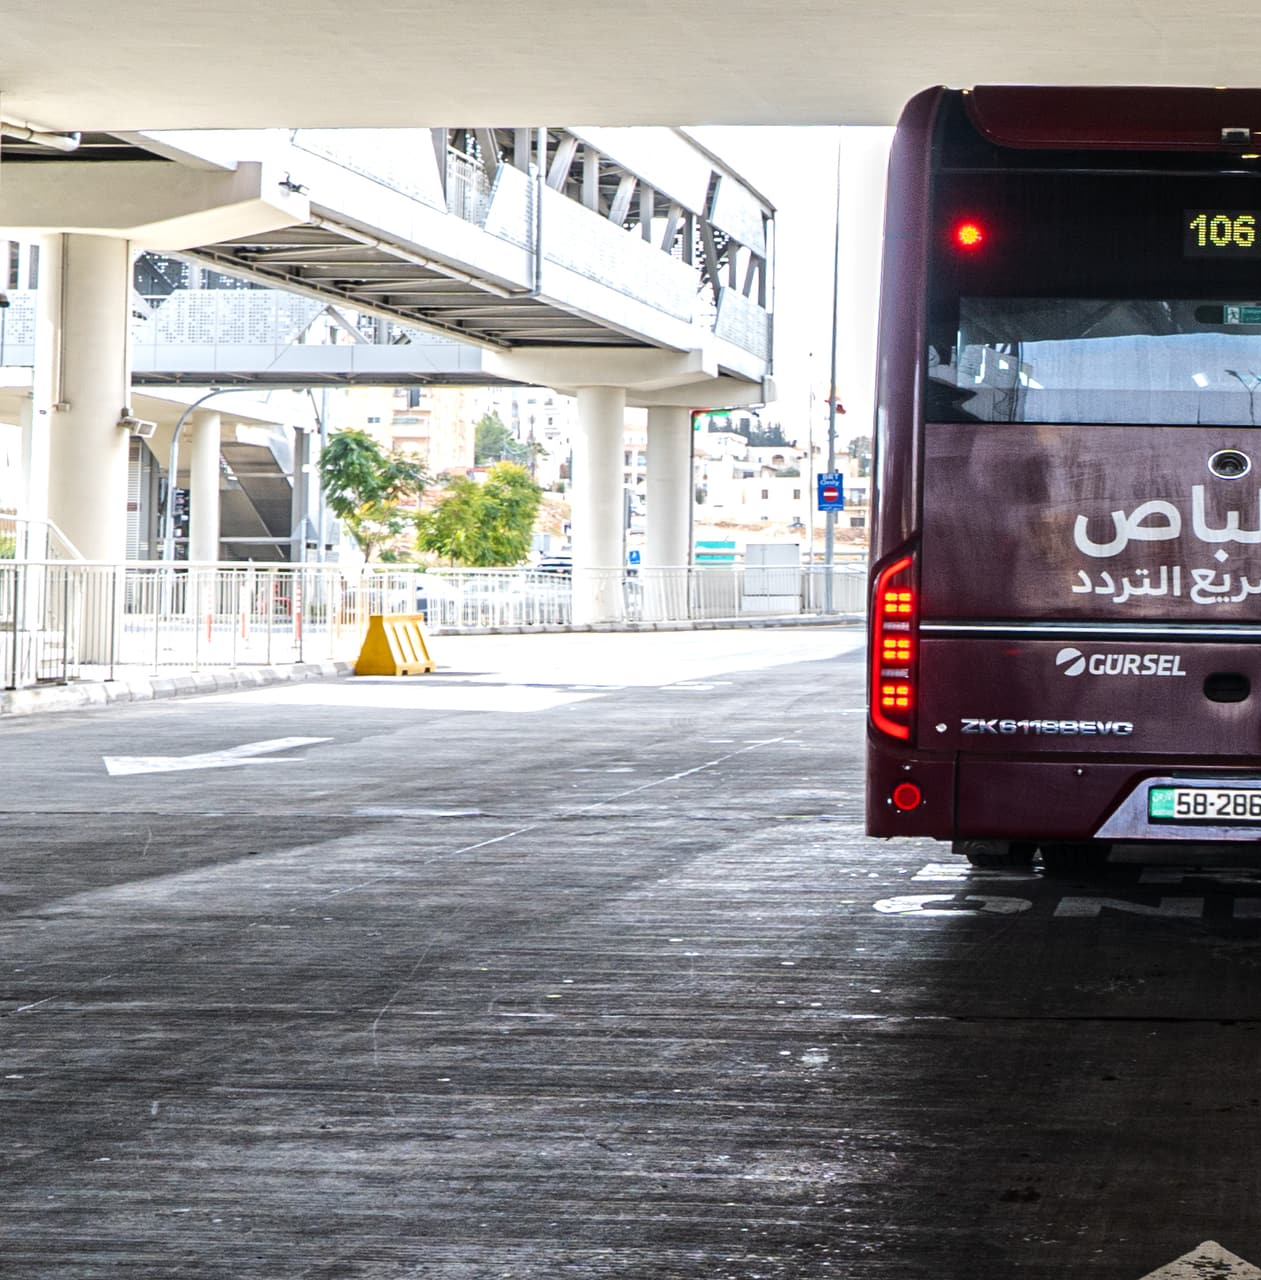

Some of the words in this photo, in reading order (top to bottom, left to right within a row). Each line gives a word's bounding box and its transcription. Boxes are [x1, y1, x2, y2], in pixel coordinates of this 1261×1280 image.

[1189, 214, 1256, 246] 106
[1071, 565, 1181, 604] التردد
[1088, 653, 1187, 677] GÜRSEL
